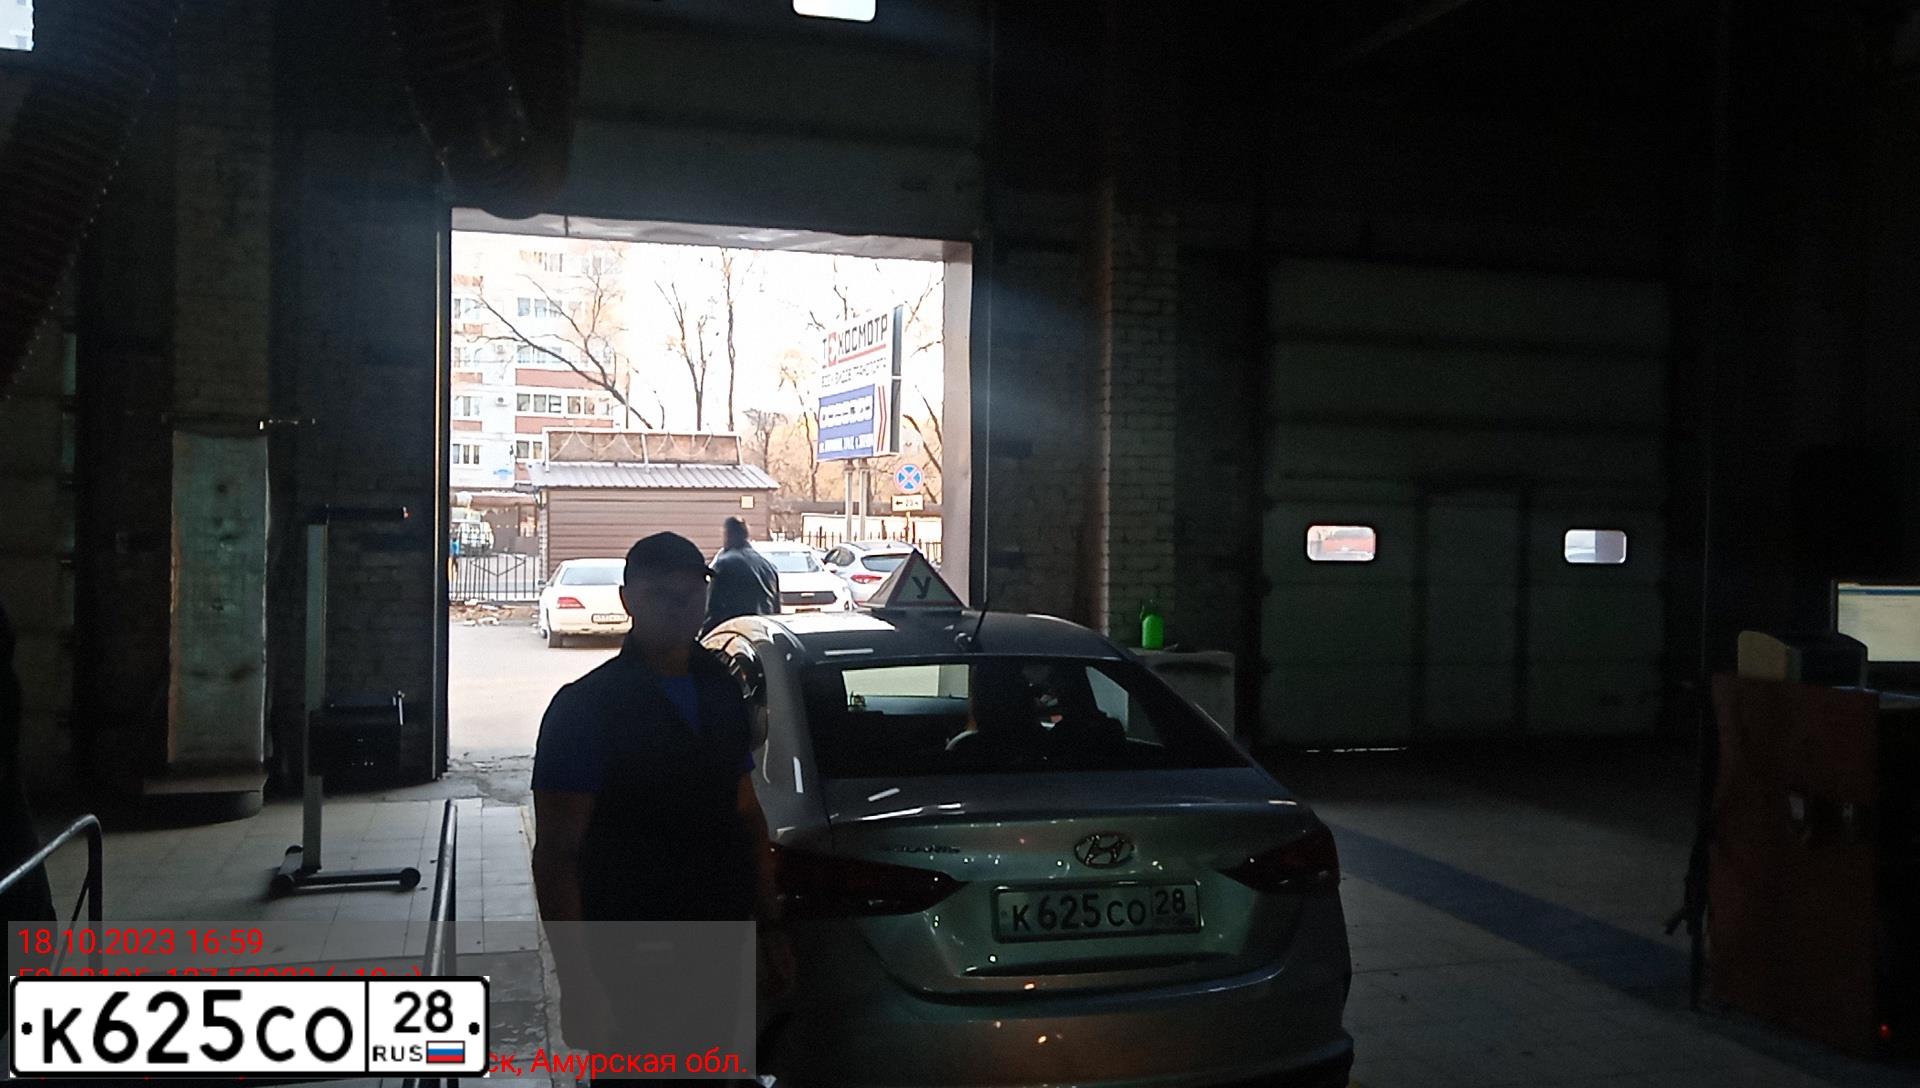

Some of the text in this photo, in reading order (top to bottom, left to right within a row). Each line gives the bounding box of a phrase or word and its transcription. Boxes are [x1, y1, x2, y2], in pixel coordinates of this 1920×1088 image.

[822, 313, 888, 368] ТЕХОСМОТР
[911, 575, 932, 599] У
[1155, 888, 1187, 915] 28
